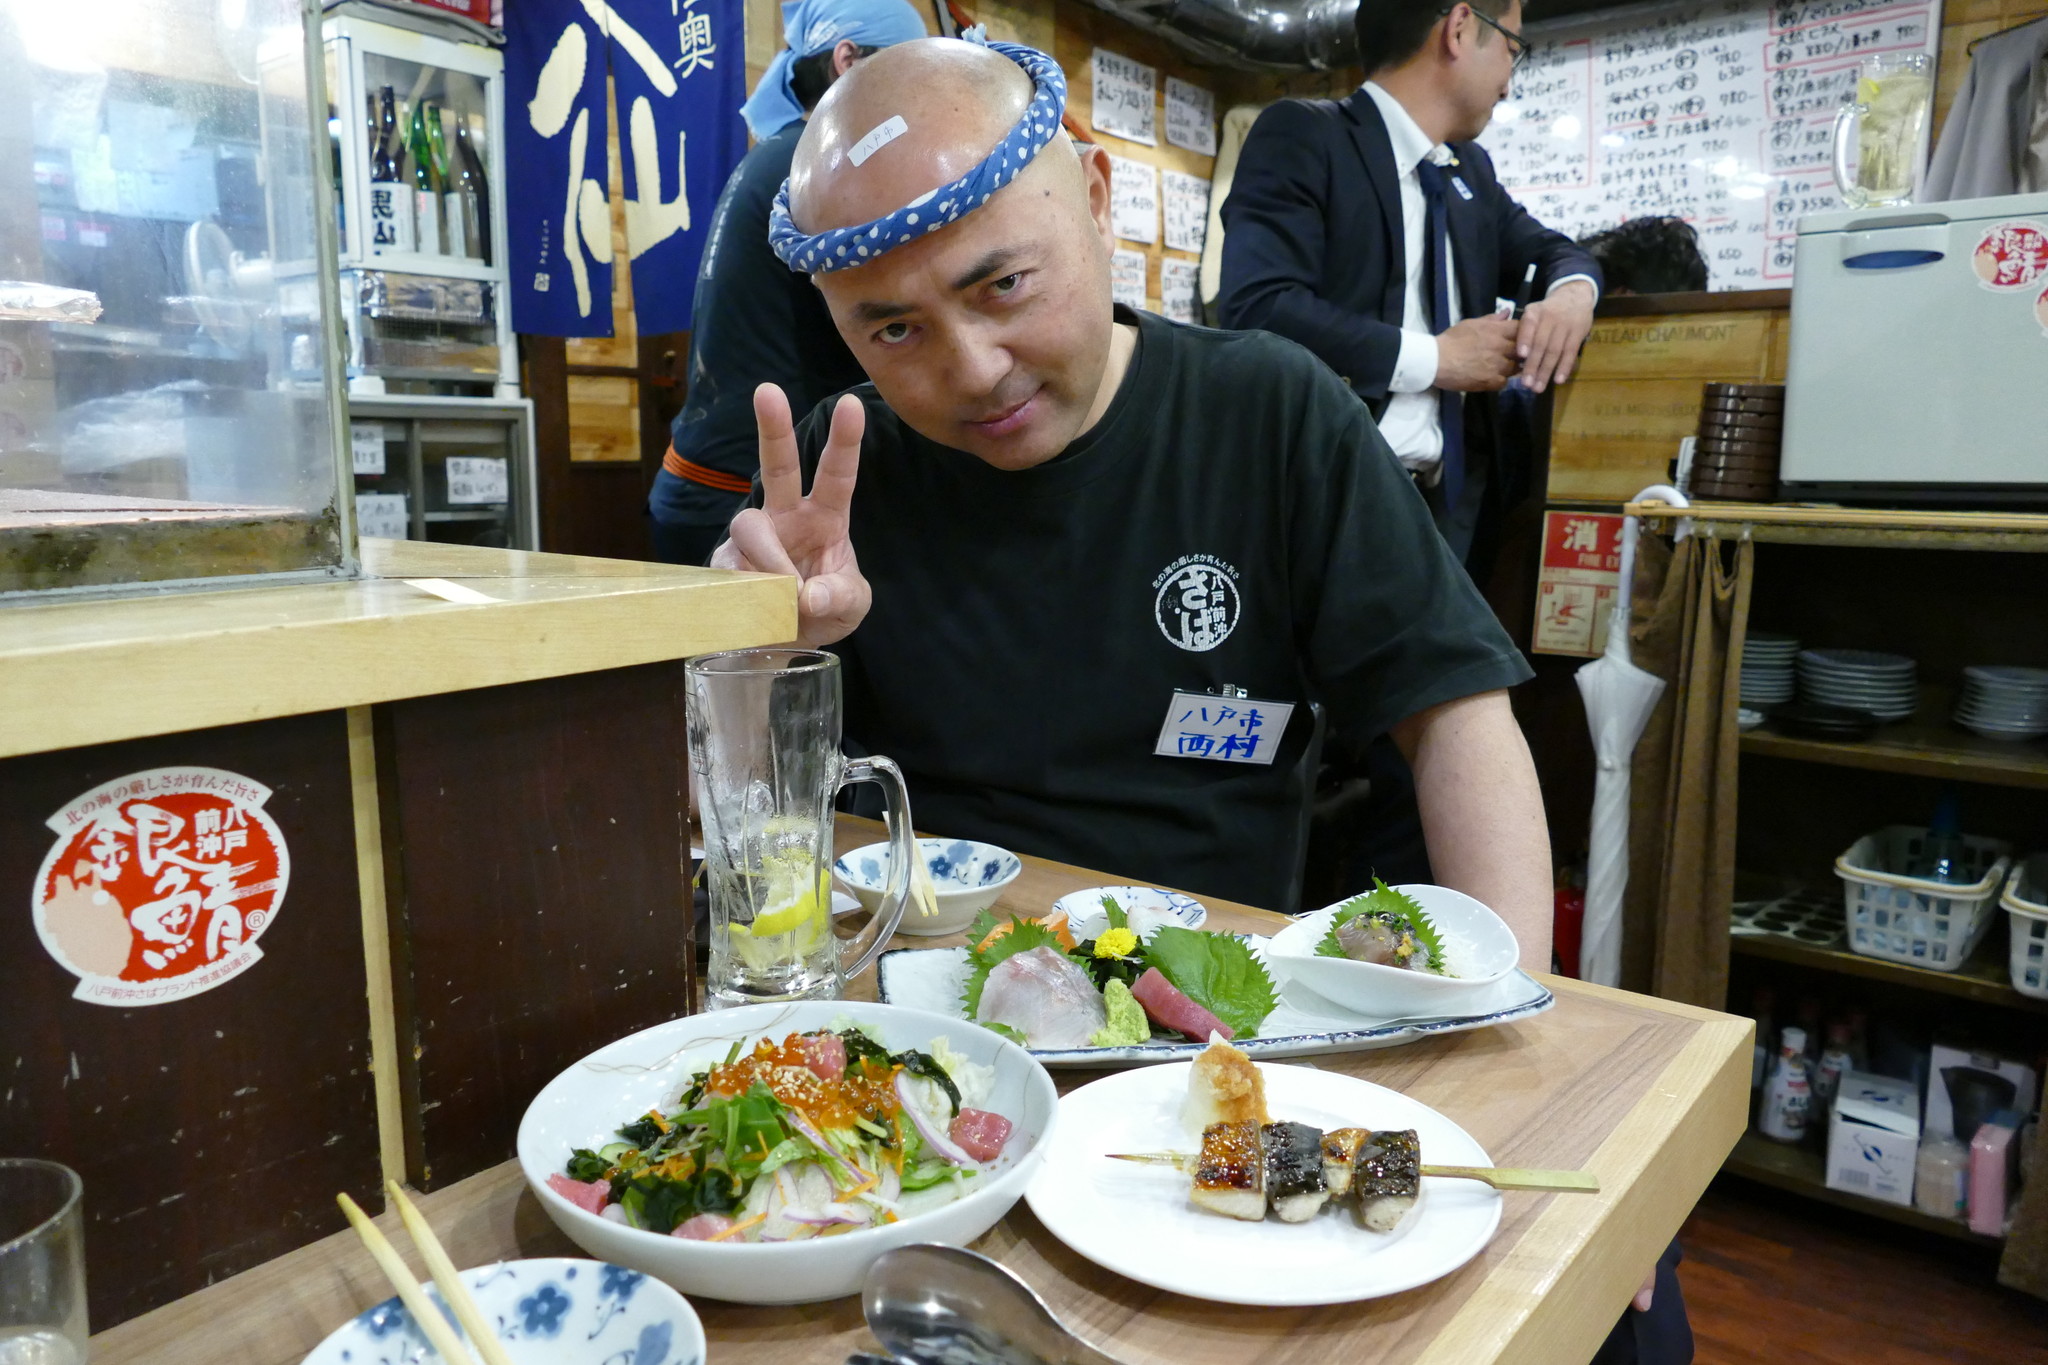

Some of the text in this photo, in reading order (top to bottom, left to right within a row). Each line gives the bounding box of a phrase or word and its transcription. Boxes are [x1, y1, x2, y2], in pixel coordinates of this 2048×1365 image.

[1178, 705, 1264, 736] 八戸市
[1178, 731, 1264, 760] 西村
[65, 773, 261, 826] 北の海の厳しさが育んだ旨さ
